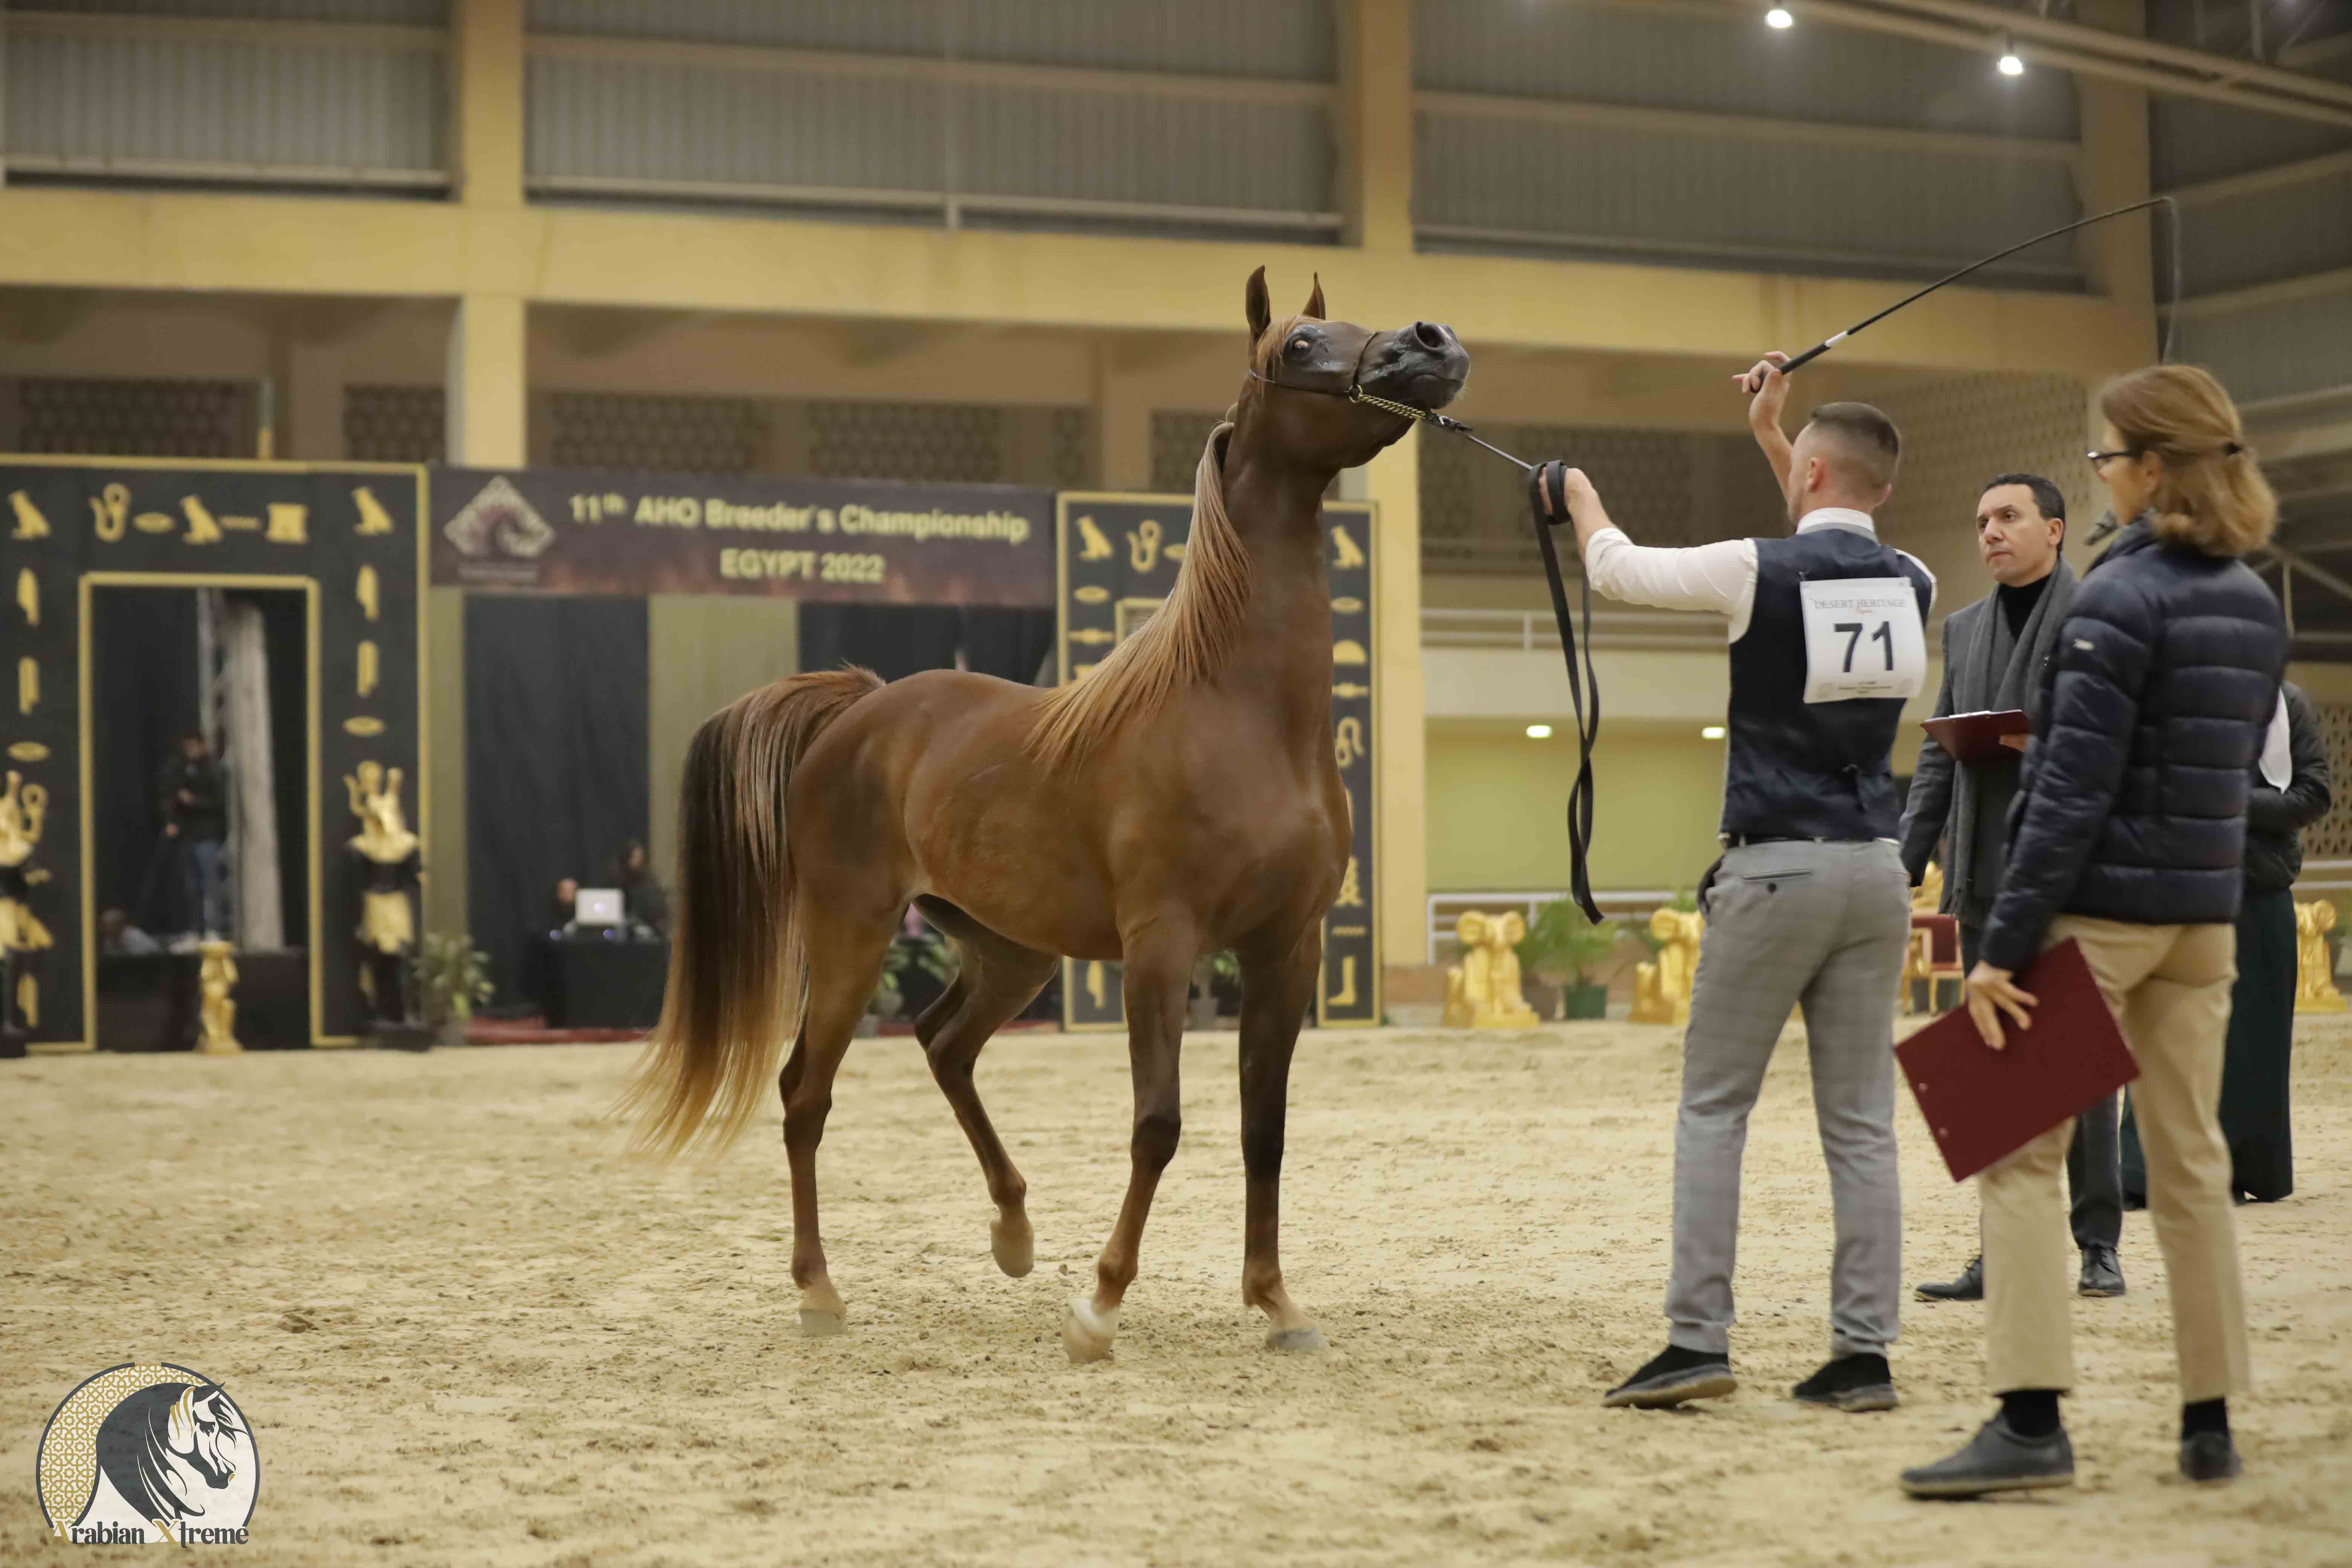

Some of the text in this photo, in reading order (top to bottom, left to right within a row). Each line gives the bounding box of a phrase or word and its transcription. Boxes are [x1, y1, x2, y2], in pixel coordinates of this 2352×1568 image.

[839, 504, 1029, 545] Championship
[720, 548, 885, 583] EGYPT 2022
[1814, 599, 1906, 609] DESERT HERITAGE
[1834, 621, 1893, 672] 71
